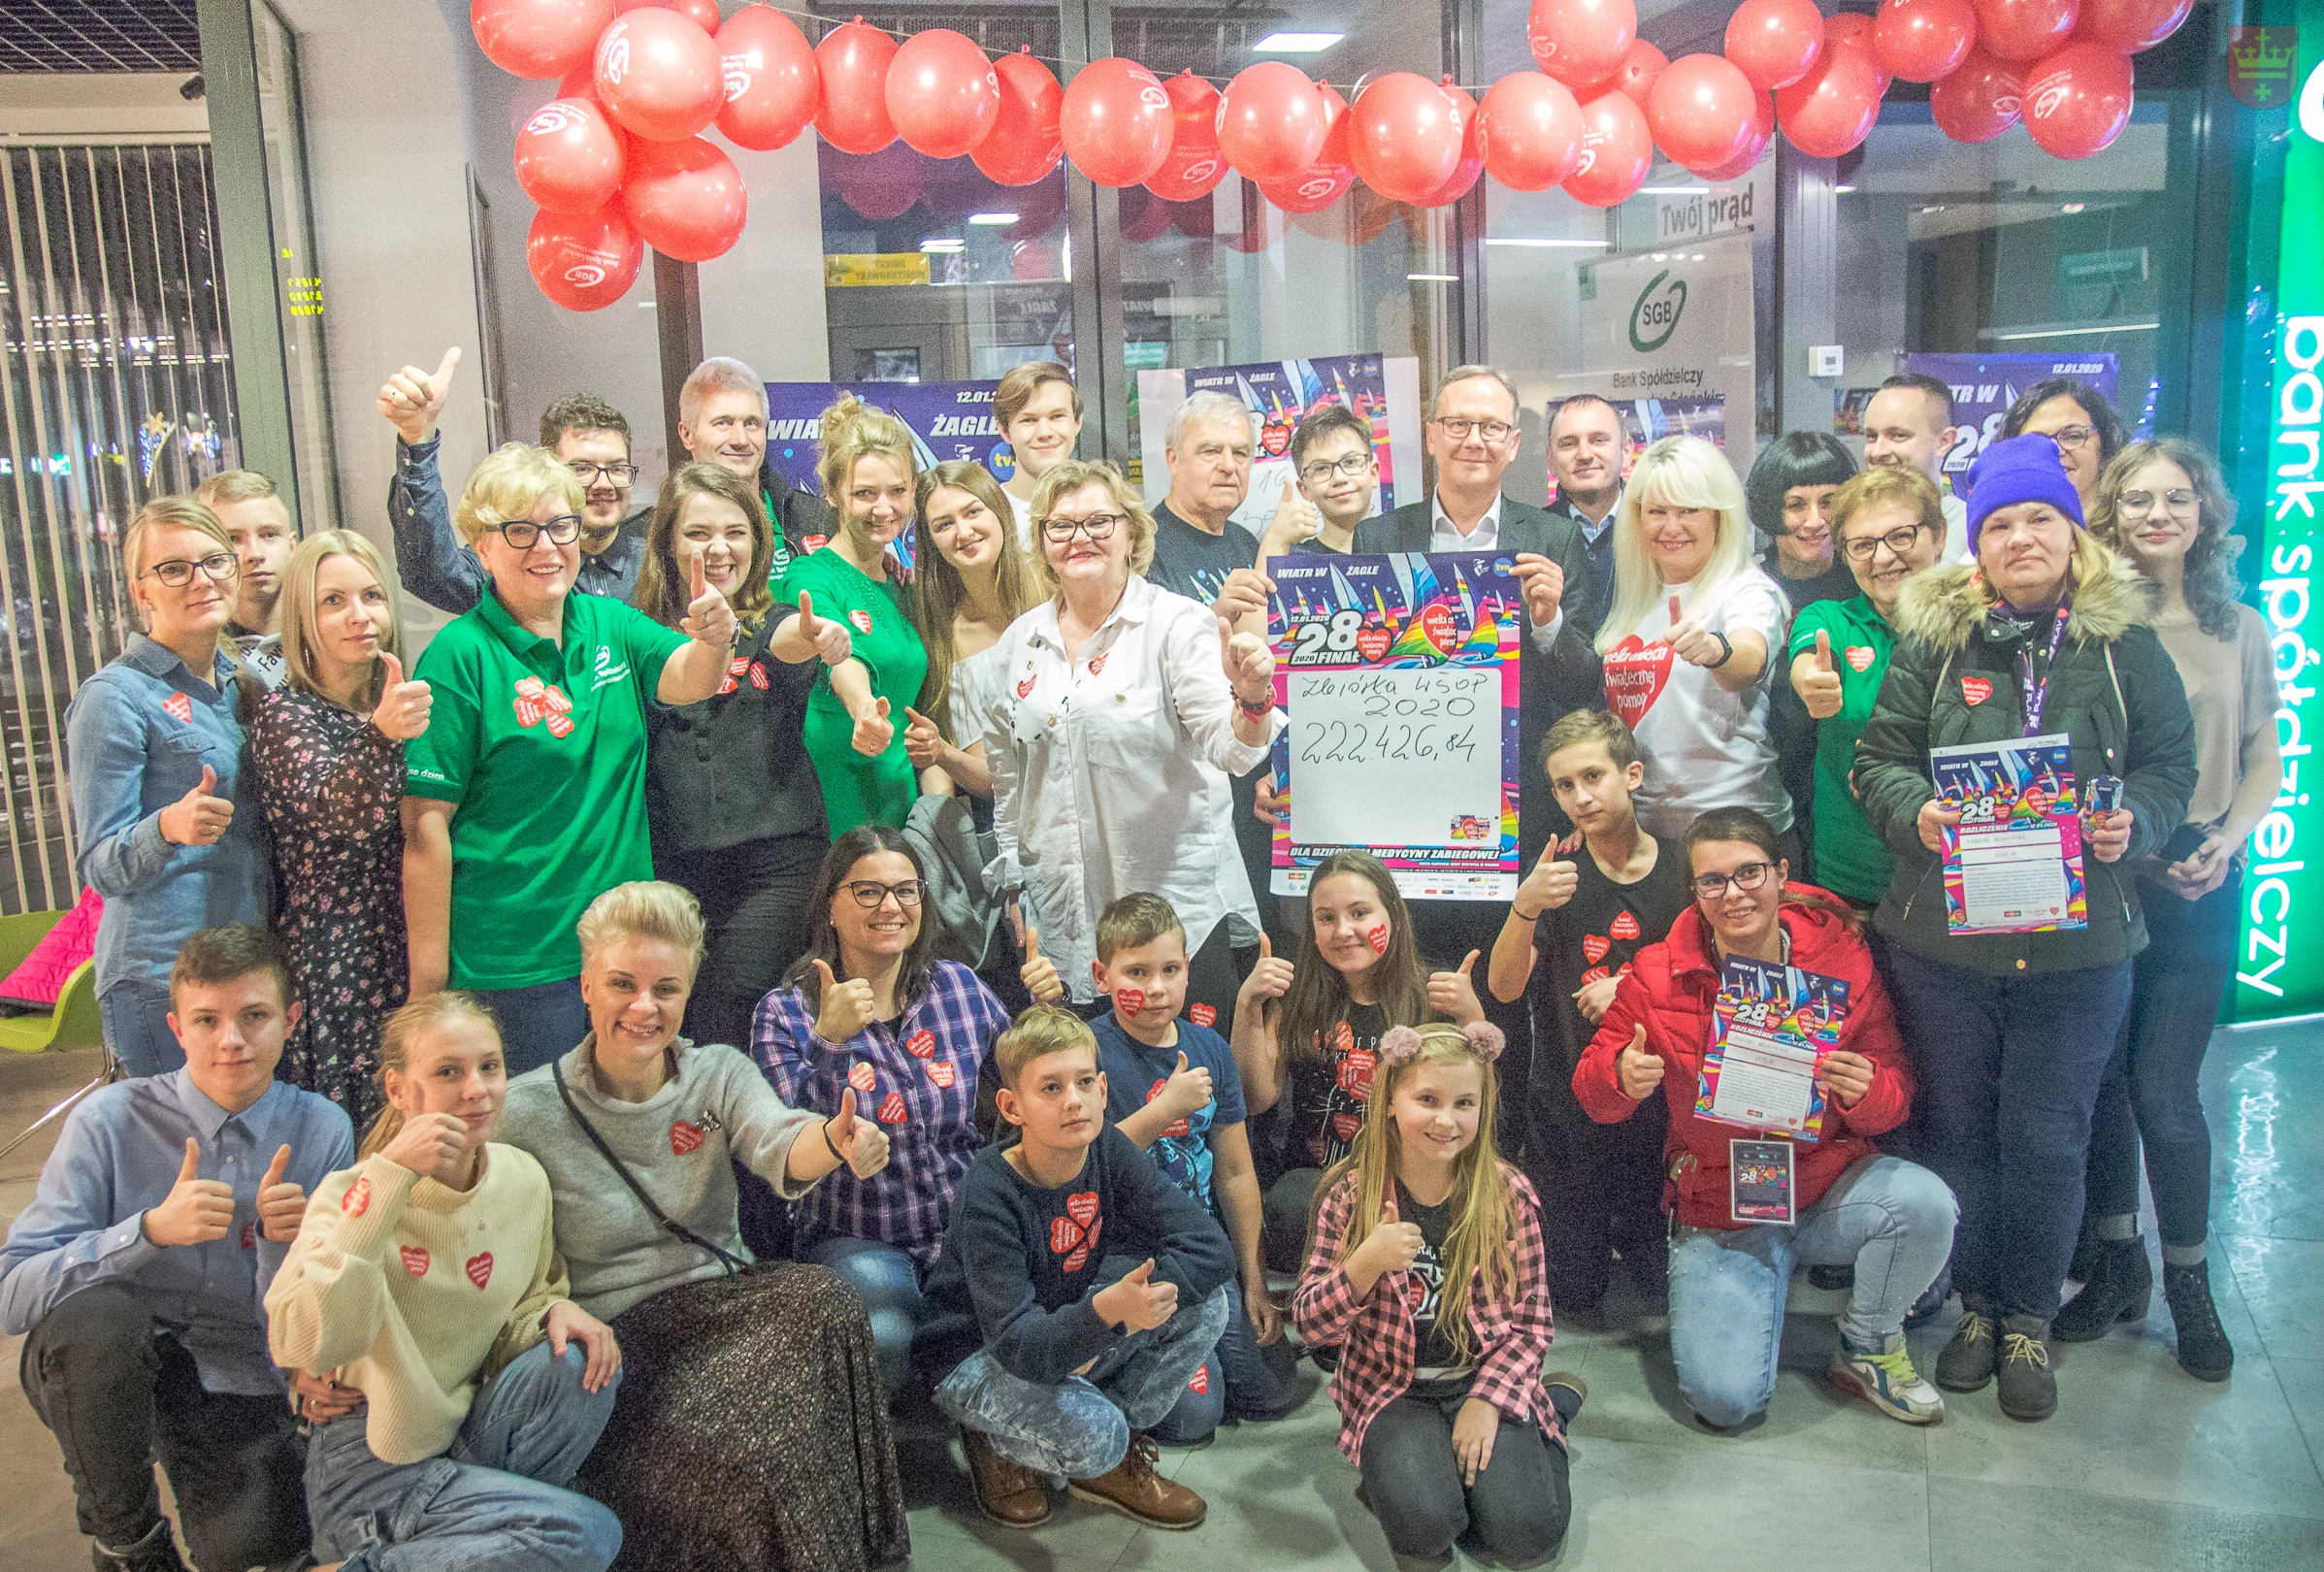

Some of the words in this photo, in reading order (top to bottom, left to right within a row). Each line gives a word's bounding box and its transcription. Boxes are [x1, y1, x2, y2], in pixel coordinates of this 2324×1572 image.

[1661, 198, 1703, 236] Twój
[1708, 182, 1754, 228] prąd
[574, 270, 595, 281] SGB
[1643, 301, 1672, 325] SGB
[2051, 363, 2104, 375] 12.01.2020
[1613, 373, 1637, 388] Bank
[1640, 368, 1704, 390] Spółdzielczy
[956, 391, 997, 404] 12.01.
[1978, 384, 1999, 403] W
[2275, 315, 2324, 522] bank
[995, 453, 1016, 467] tv
[1277, 568, 1313, 579] WIATR
[1314, 568, 1328, 578] W
[1346, 565, 1379, 576] ŻAGLE
[1291, 613, 1330, 624] 12.01.2020
[1293, 610, 1363, 664] 28
[1317, 651, 1361, 664] FINAŁ
[1364, 695, 1475, 717] 2020
[1301, 721, 1476, 764] 222.426,84
[2236, 543, 2321, 997] spółdzielczy
[1960, 796, 1996, 824] 28
[1959, 825, 2009, 835] ROZLICZENIE
[1290, 847, 1310, 856] DLA
[1371, 848, 1431, 859] MEDYCYNY
[1430, 849, 1500, 860] ZABIEGOWEJ
[1733, 1002, 1770, 1023] 28
[1730, 1024, 1774, 1039] ROZLICZENIE
